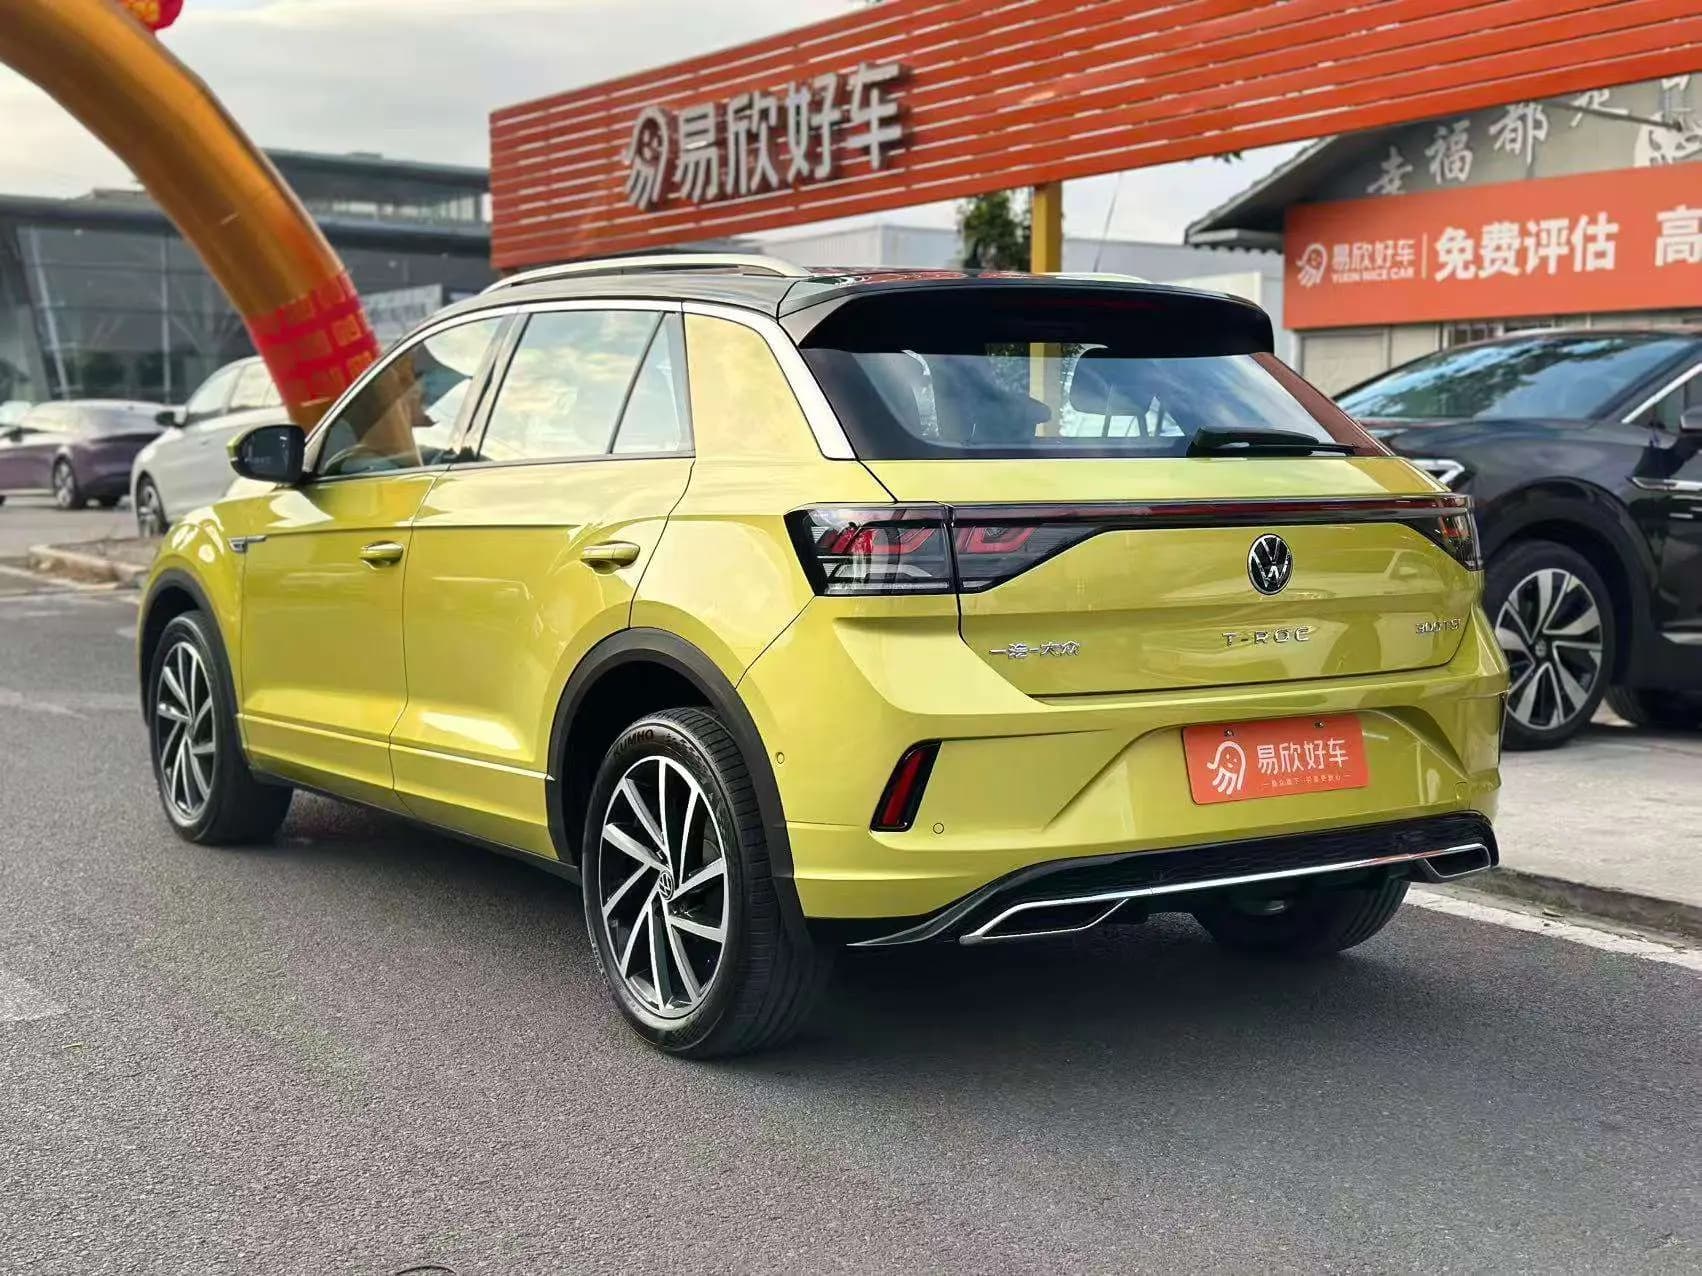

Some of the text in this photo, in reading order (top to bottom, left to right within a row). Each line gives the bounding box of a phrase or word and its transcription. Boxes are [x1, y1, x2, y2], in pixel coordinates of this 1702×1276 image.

[674, 61, 903, 203] 易欣好车
[1332, 239, 1416, 270] 易欣好车
[1434, 204, 1702, 282] 免费评估 高
[1390, 266, 1415, 279] CAR
[1221, 626, 1311, 647] T-ROC
[612, 728, 655, 757] KUMHO
[1256, 737, 1349, 776] 易欣好车
